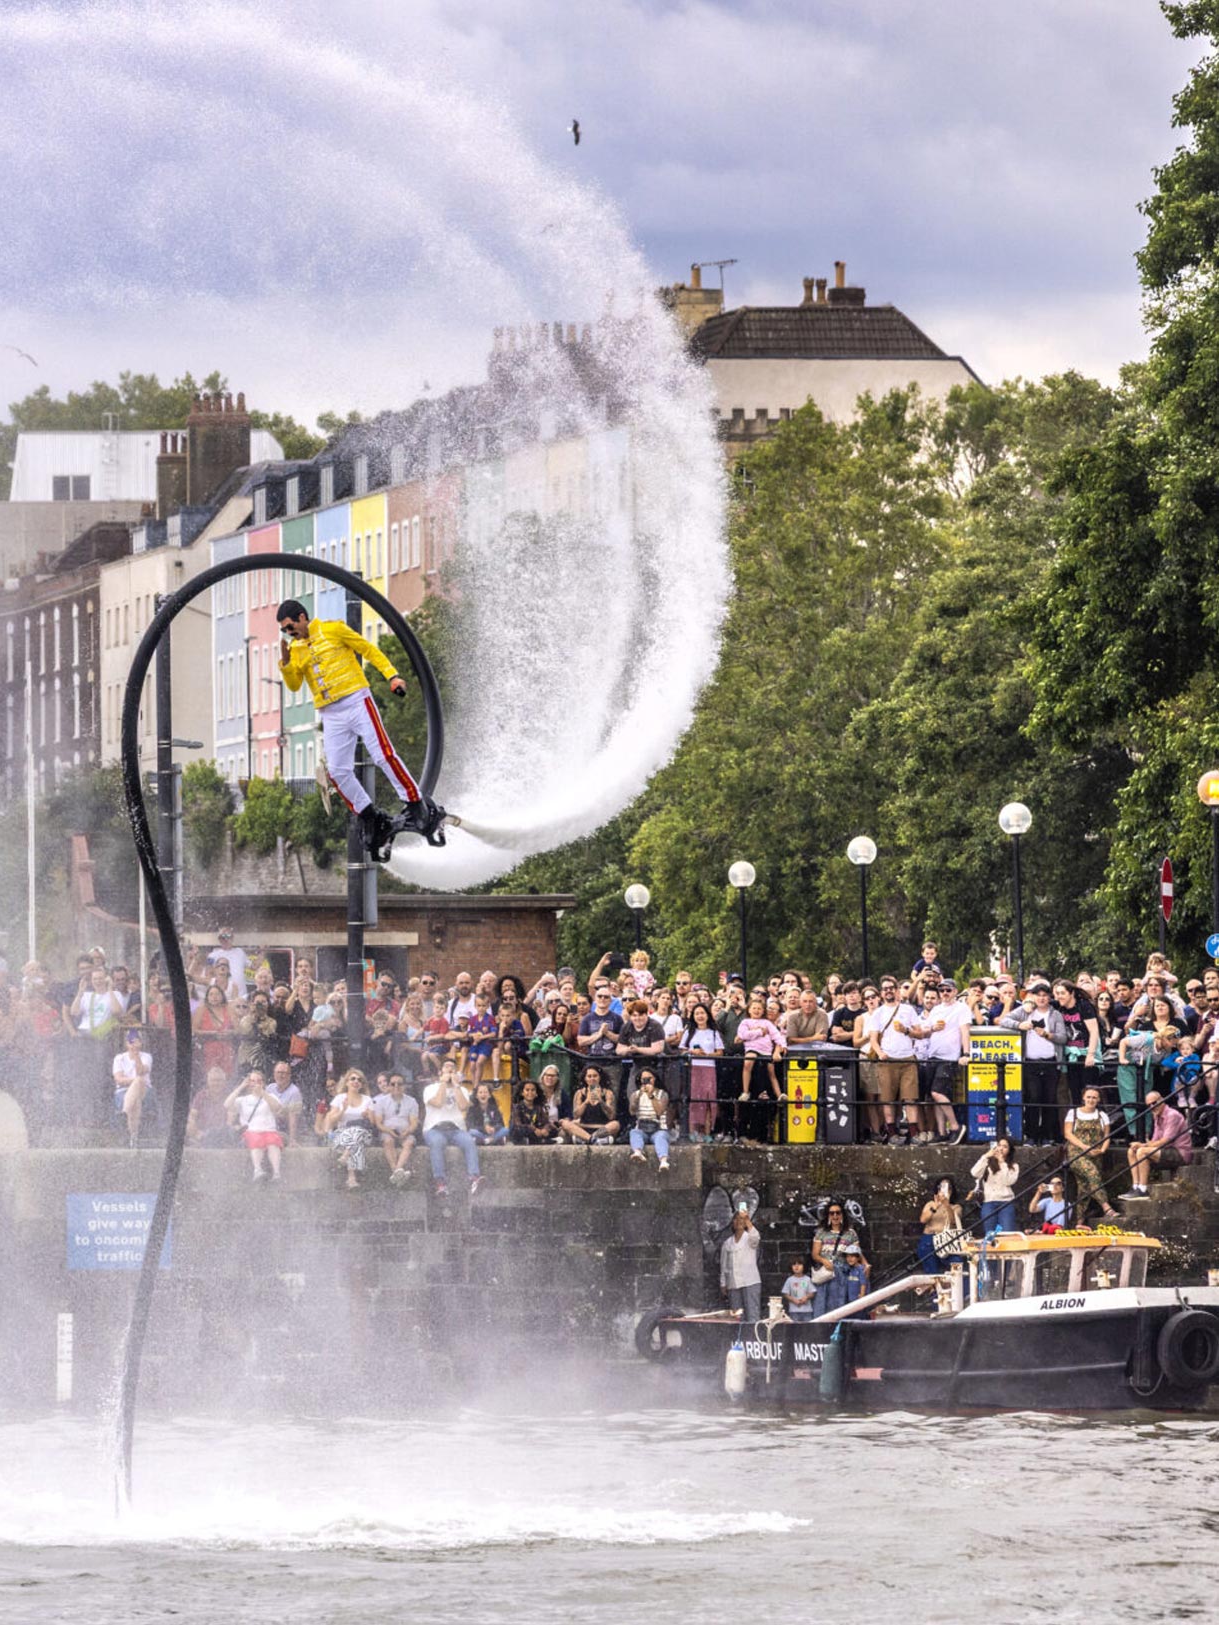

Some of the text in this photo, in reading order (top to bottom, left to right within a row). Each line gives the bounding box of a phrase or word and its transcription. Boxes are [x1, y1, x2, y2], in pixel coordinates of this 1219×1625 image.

[972, 1040, 1014, 1050] BEACH,
[972, 1052, 1018, 1062] PLEASE.
[92, 1200, 147, 1212] Vessels
[88, 1217, 151, 1231] give way
[75, 1234, 147, 1245] to oncomi
[97, 1250, 143, 1262] traffic
[1040, 1298, 1086, 1310] ALBION
[731, 1341, 829, 1361] RBOU MAST
